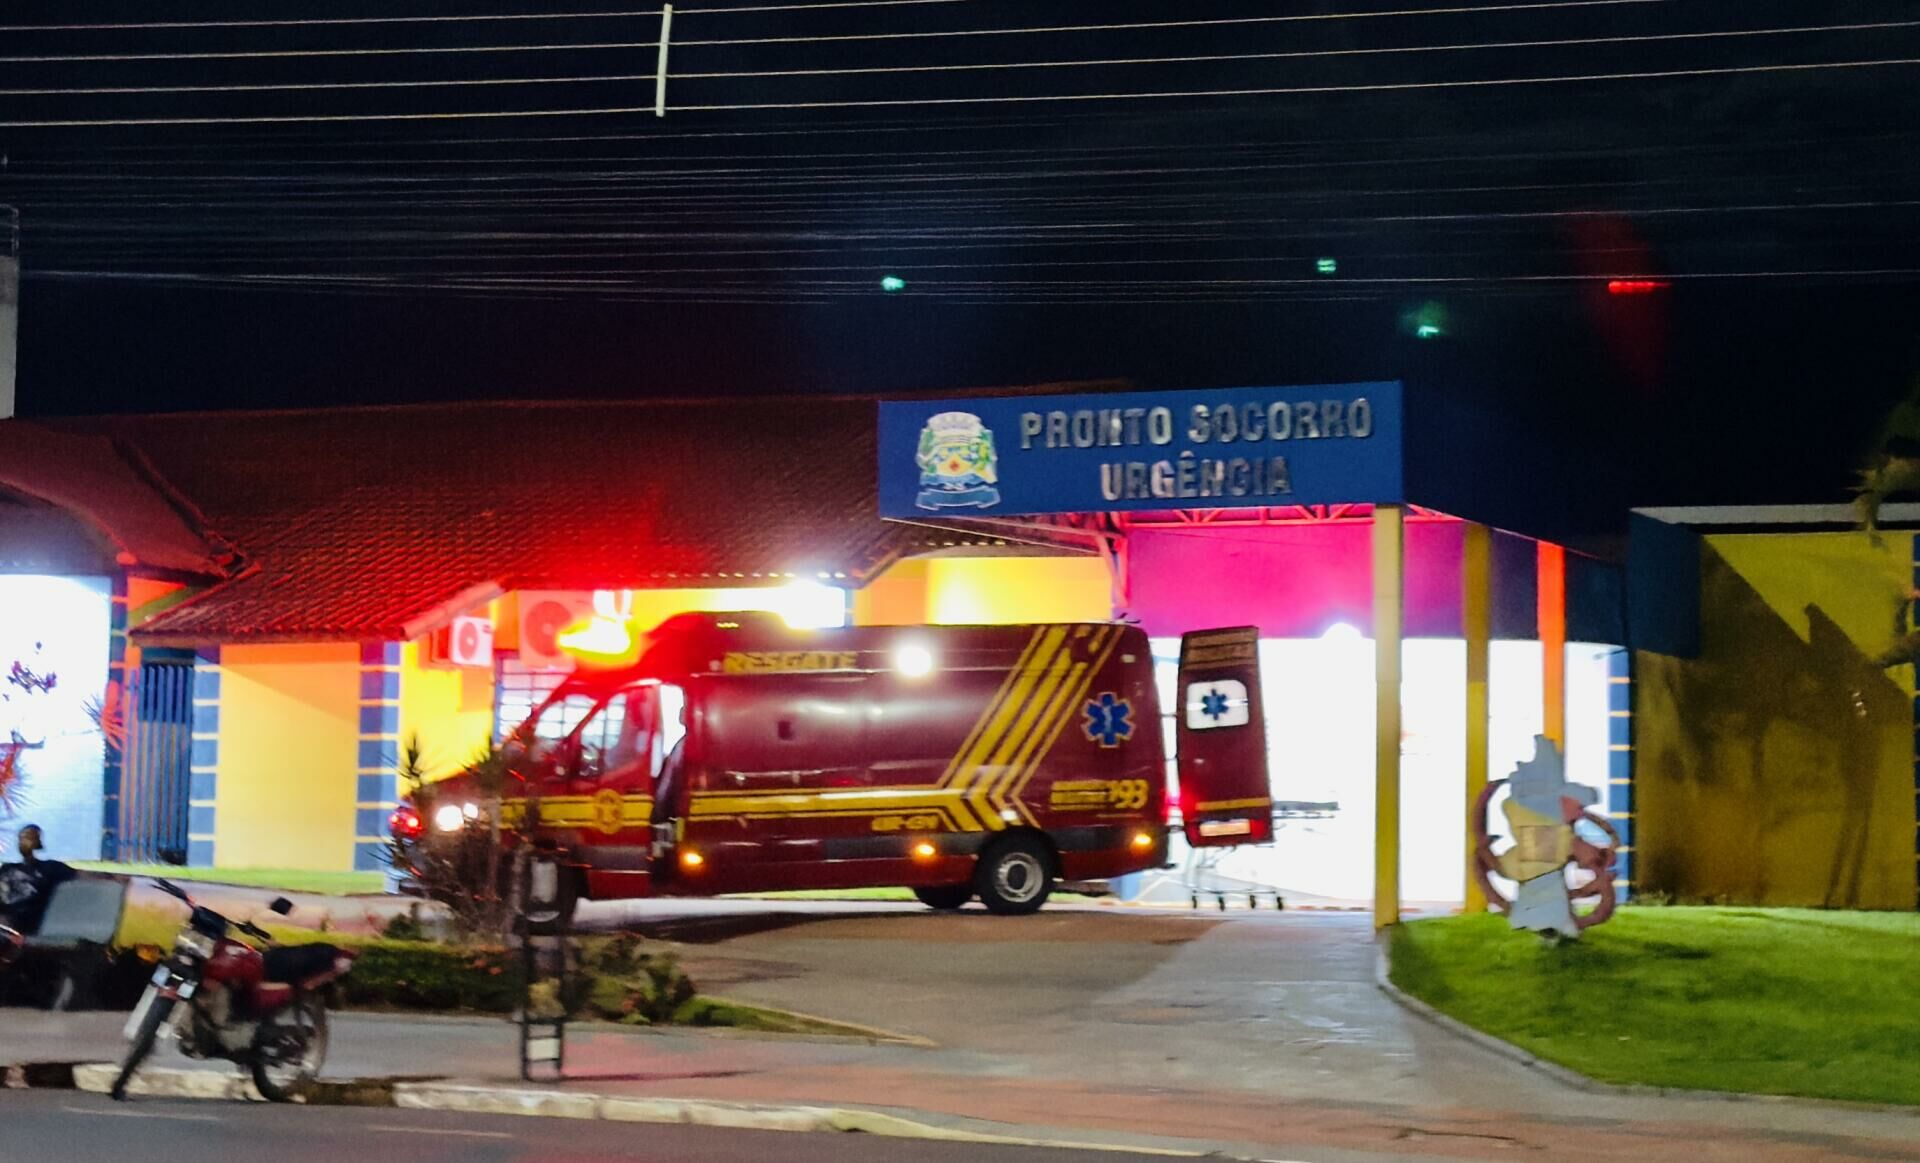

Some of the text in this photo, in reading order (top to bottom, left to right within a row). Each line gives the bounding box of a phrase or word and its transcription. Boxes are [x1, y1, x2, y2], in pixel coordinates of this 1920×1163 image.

[1020, 398, 1371, 450] PRONTO SOCORRO
[1102, 450, 1293, 501] URGÊNCIA
[1107, 779, 1148, 809] 193
